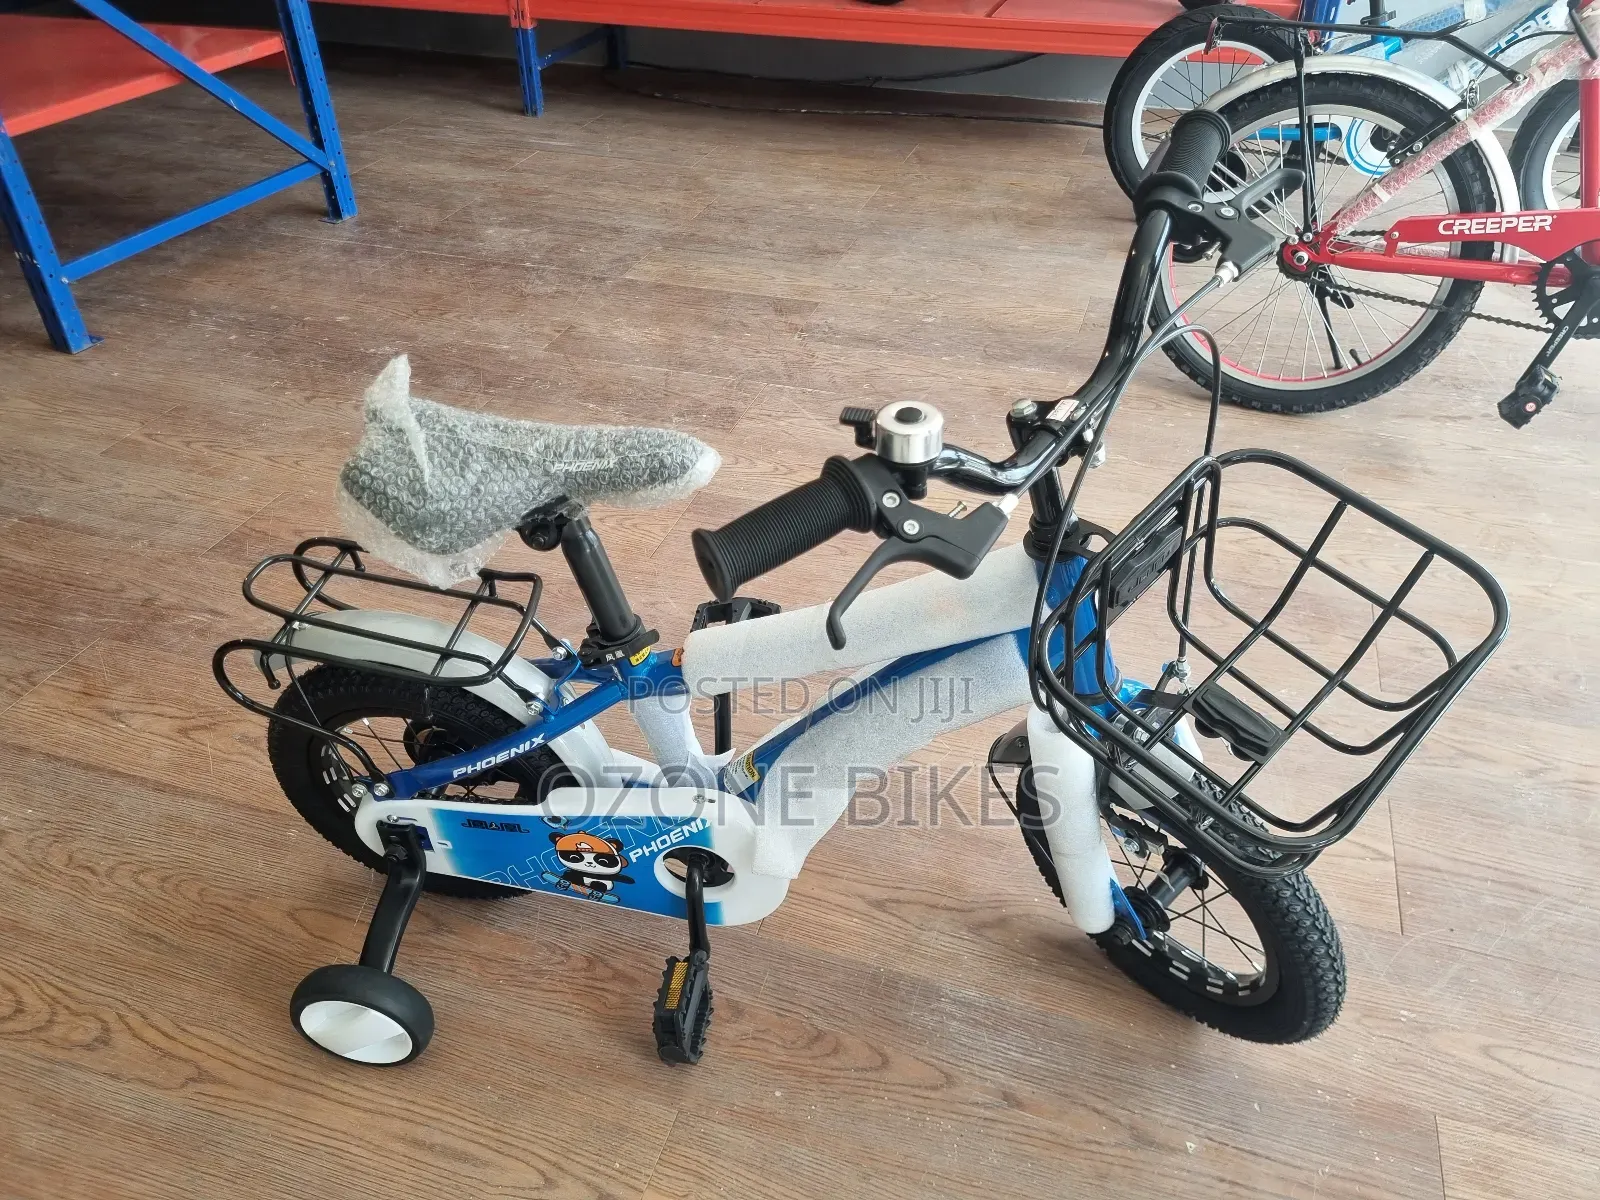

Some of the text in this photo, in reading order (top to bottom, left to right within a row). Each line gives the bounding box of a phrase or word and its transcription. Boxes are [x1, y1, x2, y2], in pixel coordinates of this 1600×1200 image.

[1438, 215, 1553, 235] CREEPER
[552, 458, 617, 473] PHOENIX
[452, 732, 545, 778] PHOENIX
